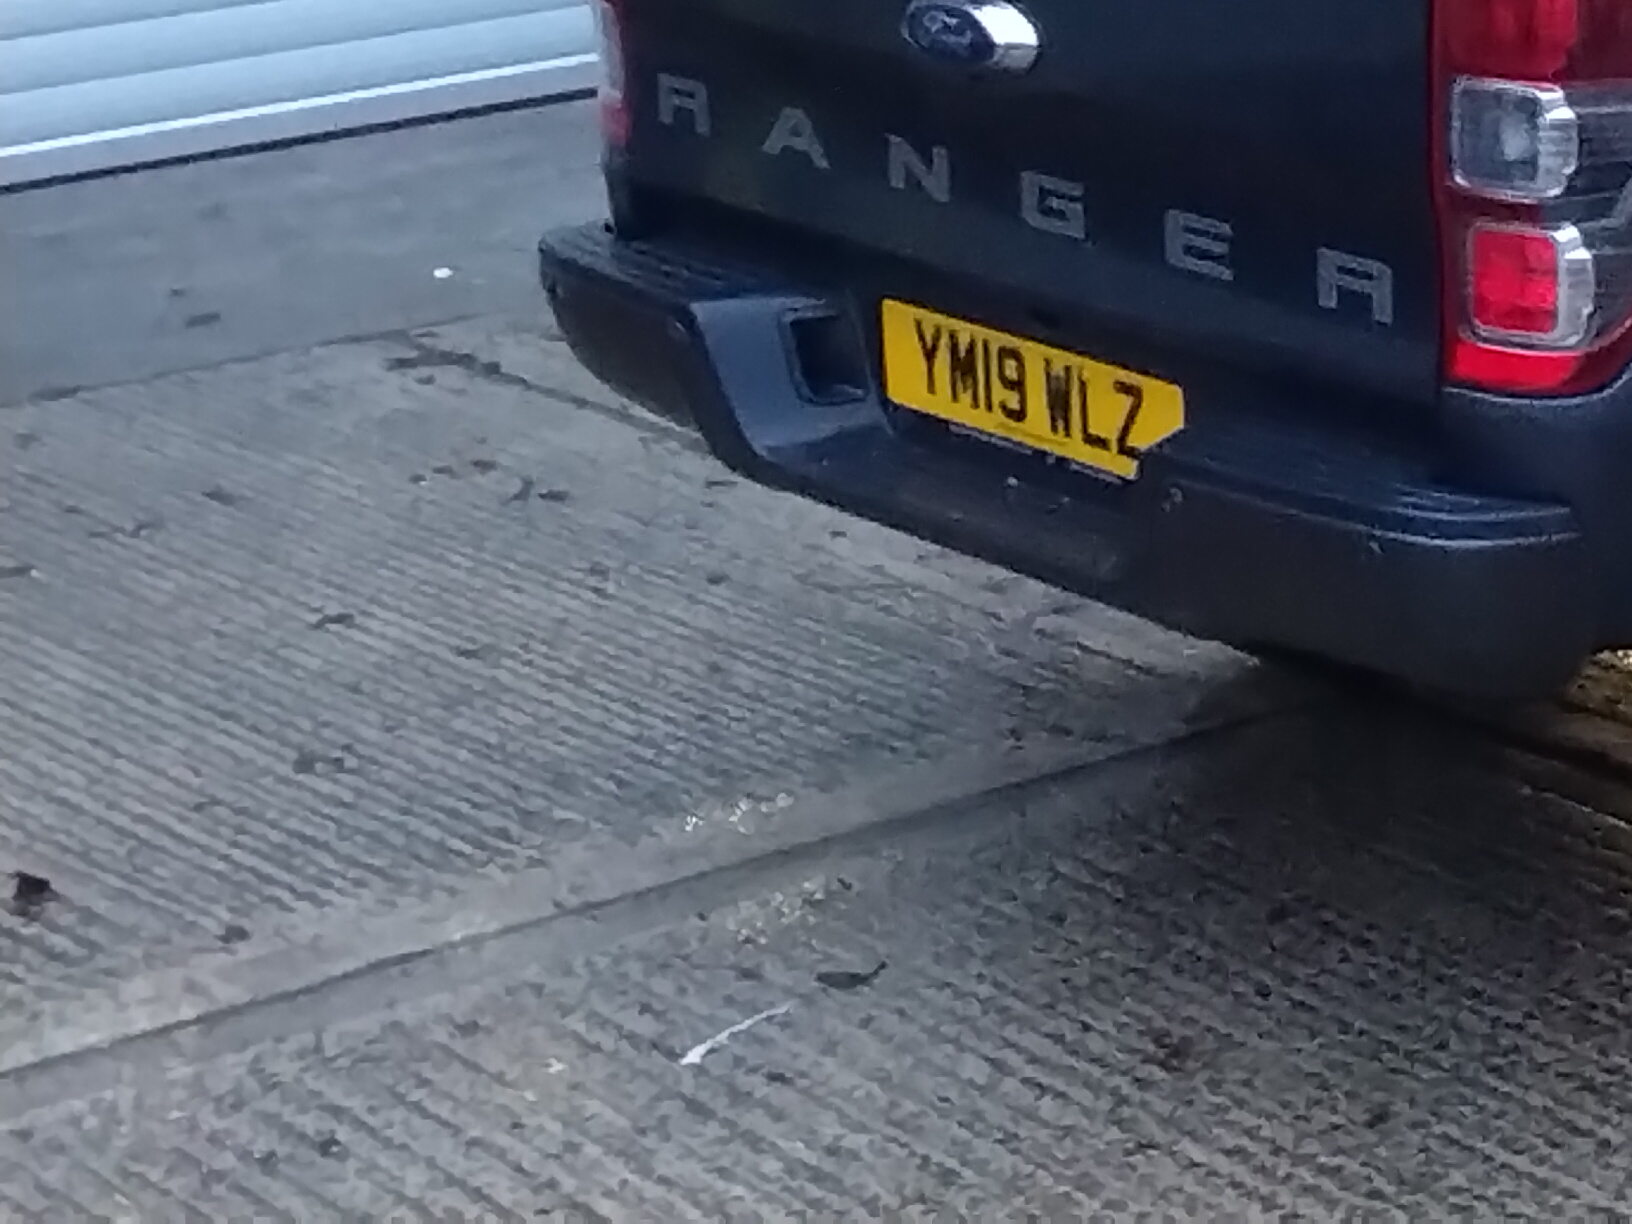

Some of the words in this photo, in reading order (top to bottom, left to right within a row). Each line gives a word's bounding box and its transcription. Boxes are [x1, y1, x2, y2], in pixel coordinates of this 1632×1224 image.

[657, 72, 1394, 325] RANGER
[914, 317, 1028, 424] YM19
[1043, 356, 1143, 460] WLZ
